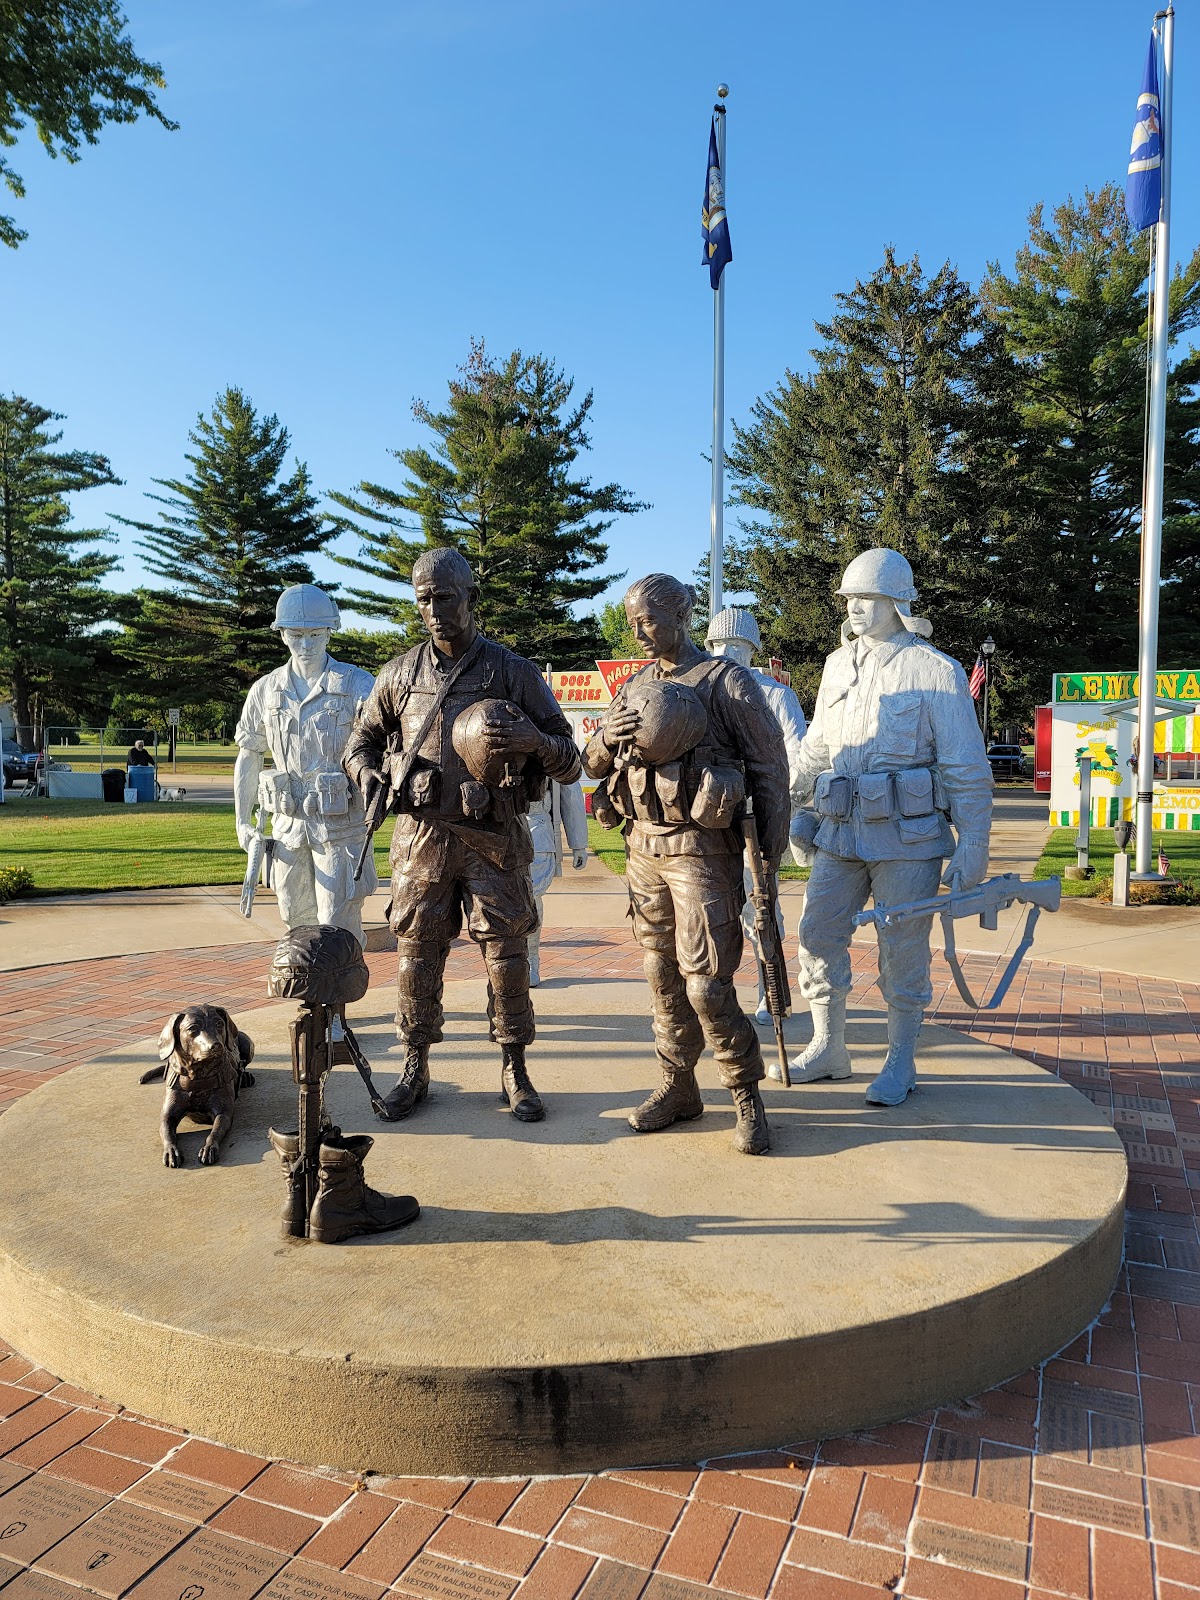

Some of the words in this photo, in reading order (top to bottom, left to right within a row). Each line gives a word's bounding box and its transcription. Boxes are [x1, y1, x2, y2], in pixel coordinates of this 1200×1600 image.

[560, 674, 592, 687] DOGS
[567, 688, 602, 702] FRIES
[39, 1493, 84, 1513] SQUADRON
[1041, 1495, 1074, 1506] UNITED
[1078, 1502, 1109, 1515] STATES
[1111, 1510, 1137, 1520] ARMY
[1113, 1503, 1139, 1514] DAVIS
[98, 1514, 128, 1527] APACHE
[124, 1522, 151, 1534] TROOP
[121, 1511, 146, 1522] CASEY
[1041, 1502, 1074, 1514] EUROPE
[1076, 1510, 1108, 1522] WORLD
[1111, 1518, 1131, 1527] WAR
[80, 1530, 94, 1538] BE
[90, 1534, 118, 1546] THOU
[115, 1542, 130, 1550] AT
[126, 1546, 154, 1558] PEACE
[115, 1531, 137, 1542] IRAQ
[186, 1545, 222, 1559] TROPIC
[216, 1555, 268, 1576] LIGHTNING
[210, 1542, 247, 1557] RANDALL
[243, 1553, 279, 1568] ZYLMAN
[187, 1568, 210, 1579] 1969
[206, 1575, 222, 1583] 06
[218, 1579, 243, 1590] 1970
[196, 1560, 239, 1577] VIETNAM
[416, 1557, 434, 1565] SGT
[433, 1562, 477, 1578] RAYMOND
[476, 1574, 513, 1589] COLLINS
[280, 1570, 297, 1579] WE
[292, 1575, 325, 1588] HONOR
[321, 1583, 344, 1594] OUR
[291, 1586, 321, 1599] CASEY
[401, 1575, 441, 1591] WESTERN
[439, 1587, 470, 1600] FRONT
[440, 1575, 484, 1593] RAILROAD
[482, 1588, 502, 1598] BAT
